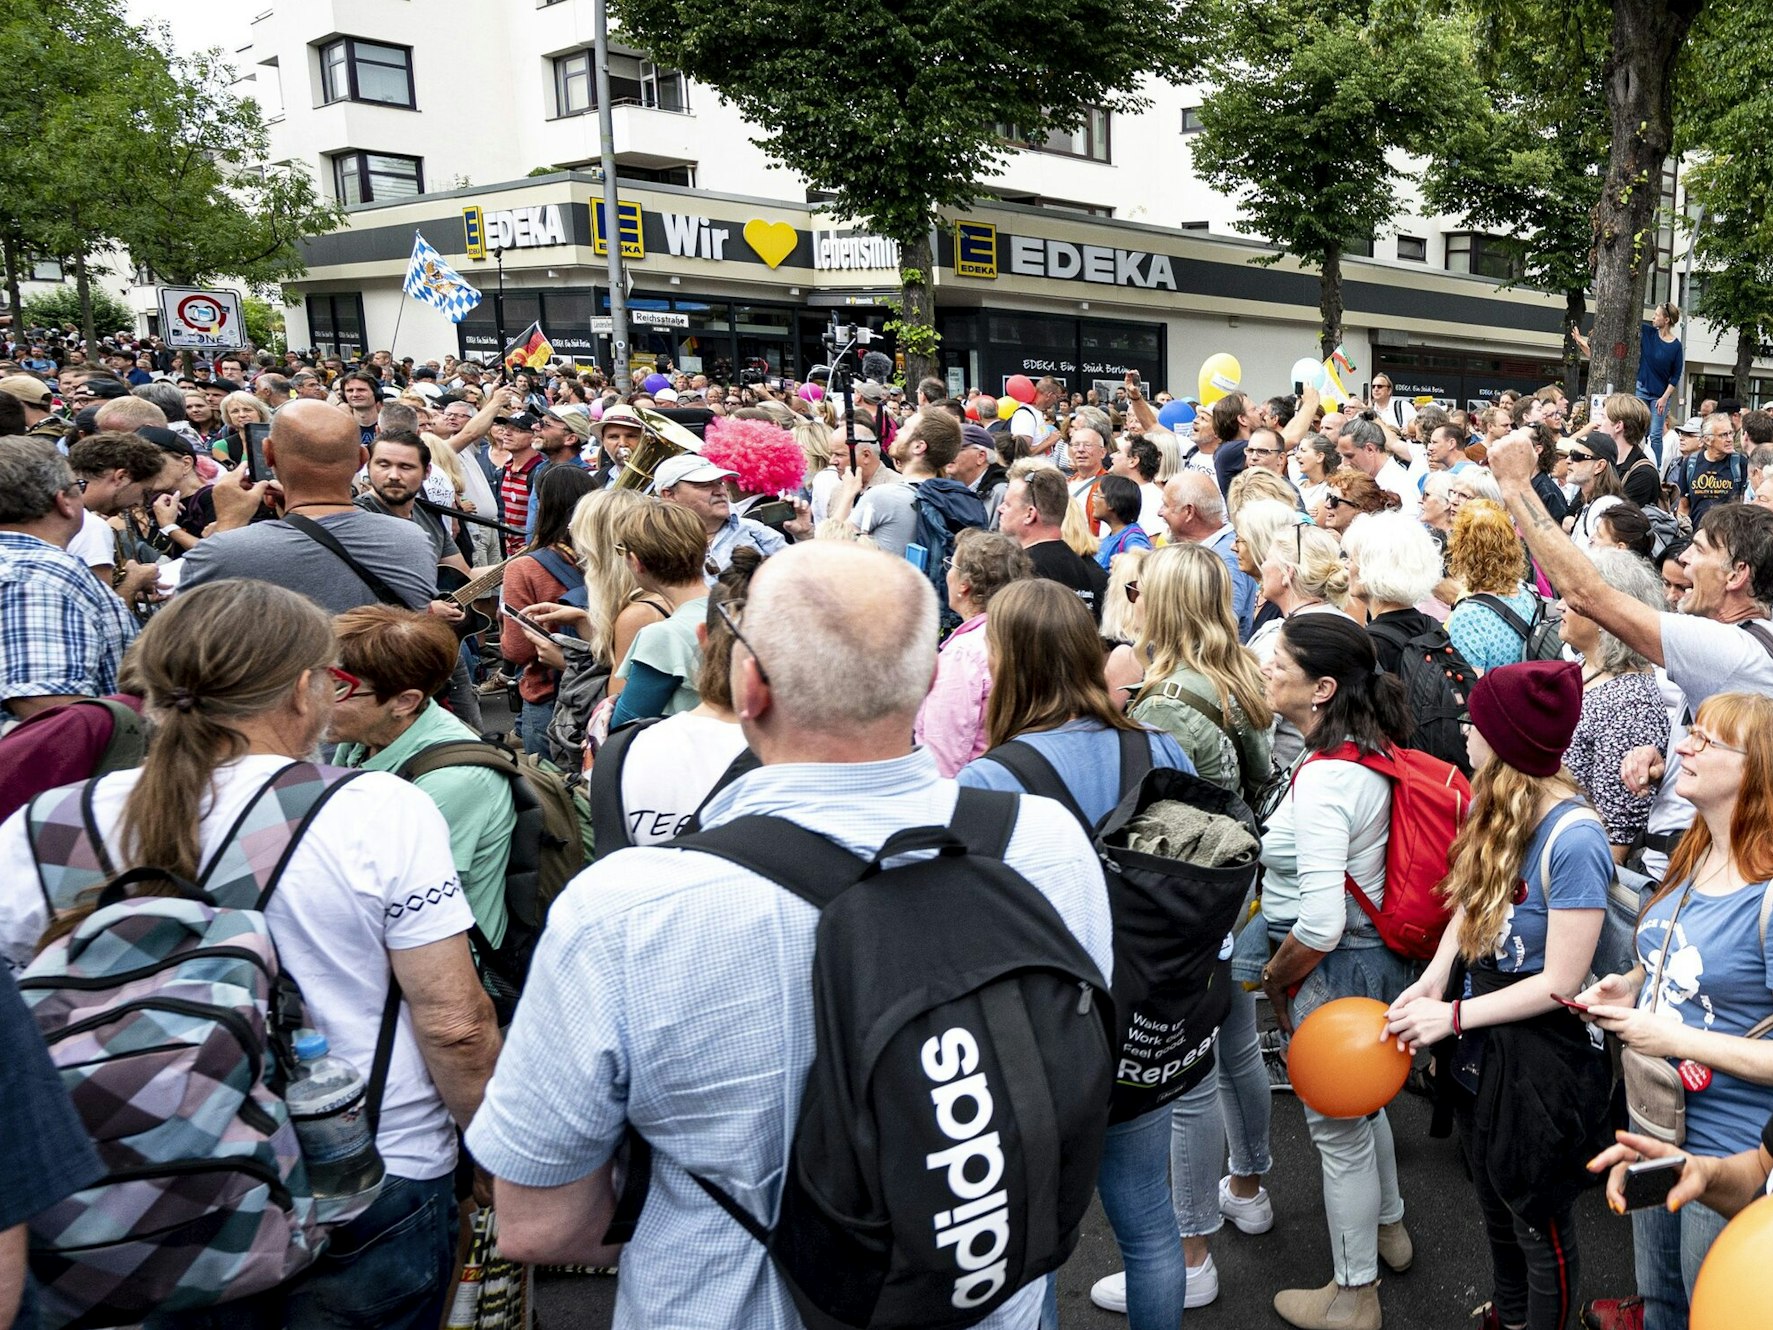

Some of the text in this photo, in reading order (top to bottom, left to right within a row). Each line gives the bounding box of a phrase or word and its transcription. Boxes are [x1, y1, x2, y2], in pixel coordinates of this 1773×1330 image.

[483, 204, 567, 250] EDEKA
[599, 242, 641, 254] EKA
[661, 212, 902, 270] Wir Lebensmit
[961, 264, 995, 275] EDEKA
[1010, 235, 1177, 290] EDEKA
[636, 312, 685, 325] Reichsstraße
[1060, 361, 1076, 372] Ein
[1082, 362, 1104, 373] Stück
[1692, 474, 1733, 489] s.Oliver
[1133, 1011, 1169, 1033] Wake
[1128, 1027, 1163, 1046] Work
[1123, 1043, 1152, 1059] Feel
[920, 1026, 1010, 1309] adidas
